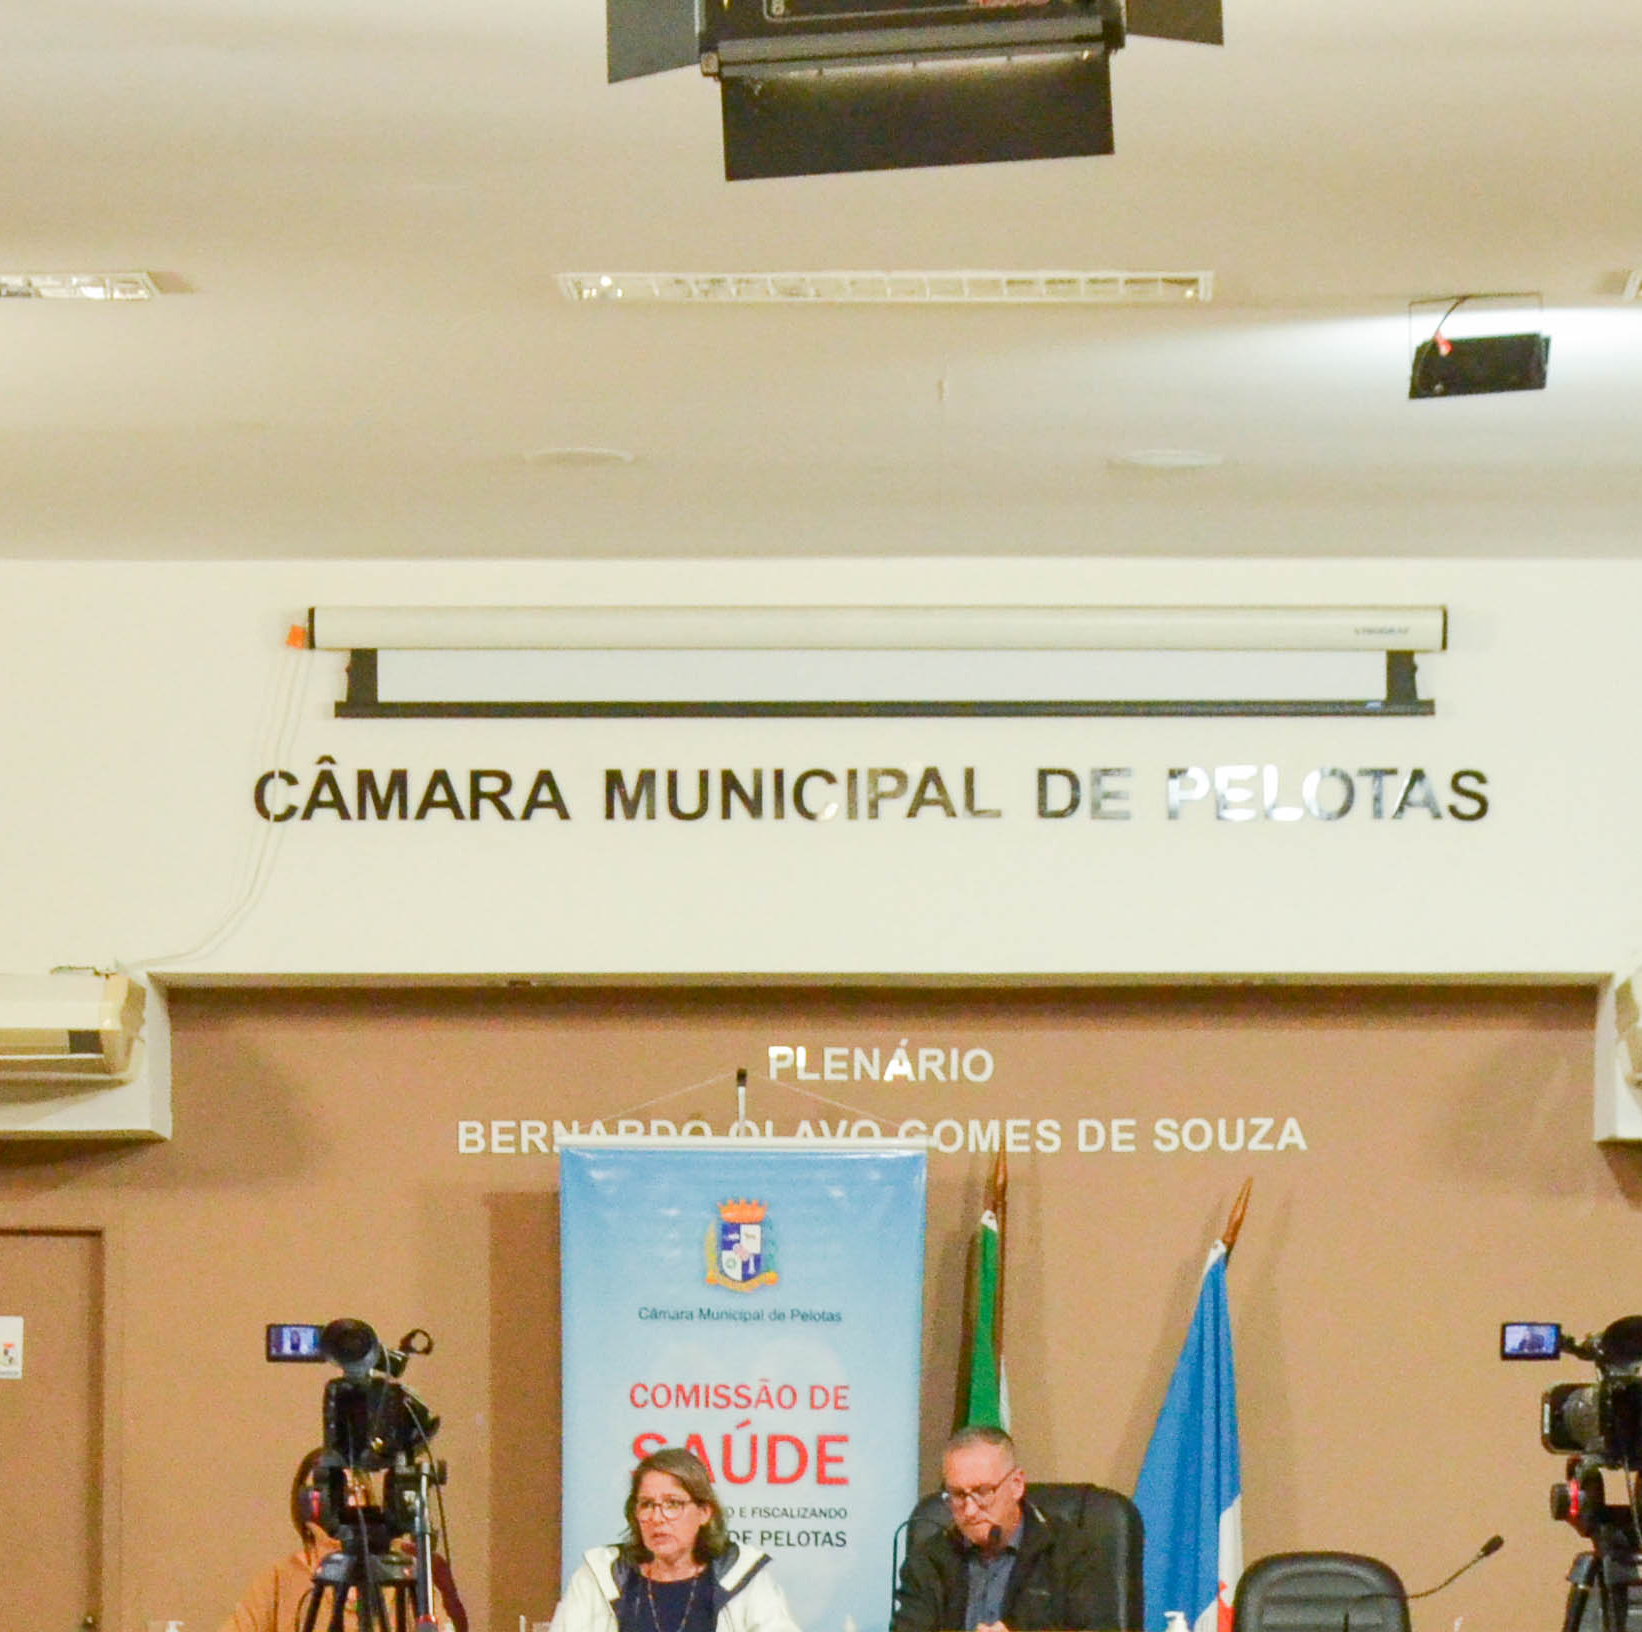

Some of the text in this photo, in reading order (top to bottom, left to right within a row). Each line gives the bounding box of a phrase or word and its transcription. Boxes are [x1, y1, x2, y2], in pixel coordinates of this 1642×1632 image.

[254, 755, 1490, 823] CÂMARA MUNICIPAL DE PELOTAS
[768, 1038, 994, 1082] PLENÁRIO
[1077, 1118, 1137, 1152] DE
[1153, 1117, 1307, 1153] SOUZA
[638, 1307, 842, 1323] Câmara Municipal de Pelotas
[629, 1377, 850, 1411] COMISSÃO DE
[751, 1506, 848, 1519] FISCALIZANDO
[760, 1530, 847, 1547] PELOTAS
